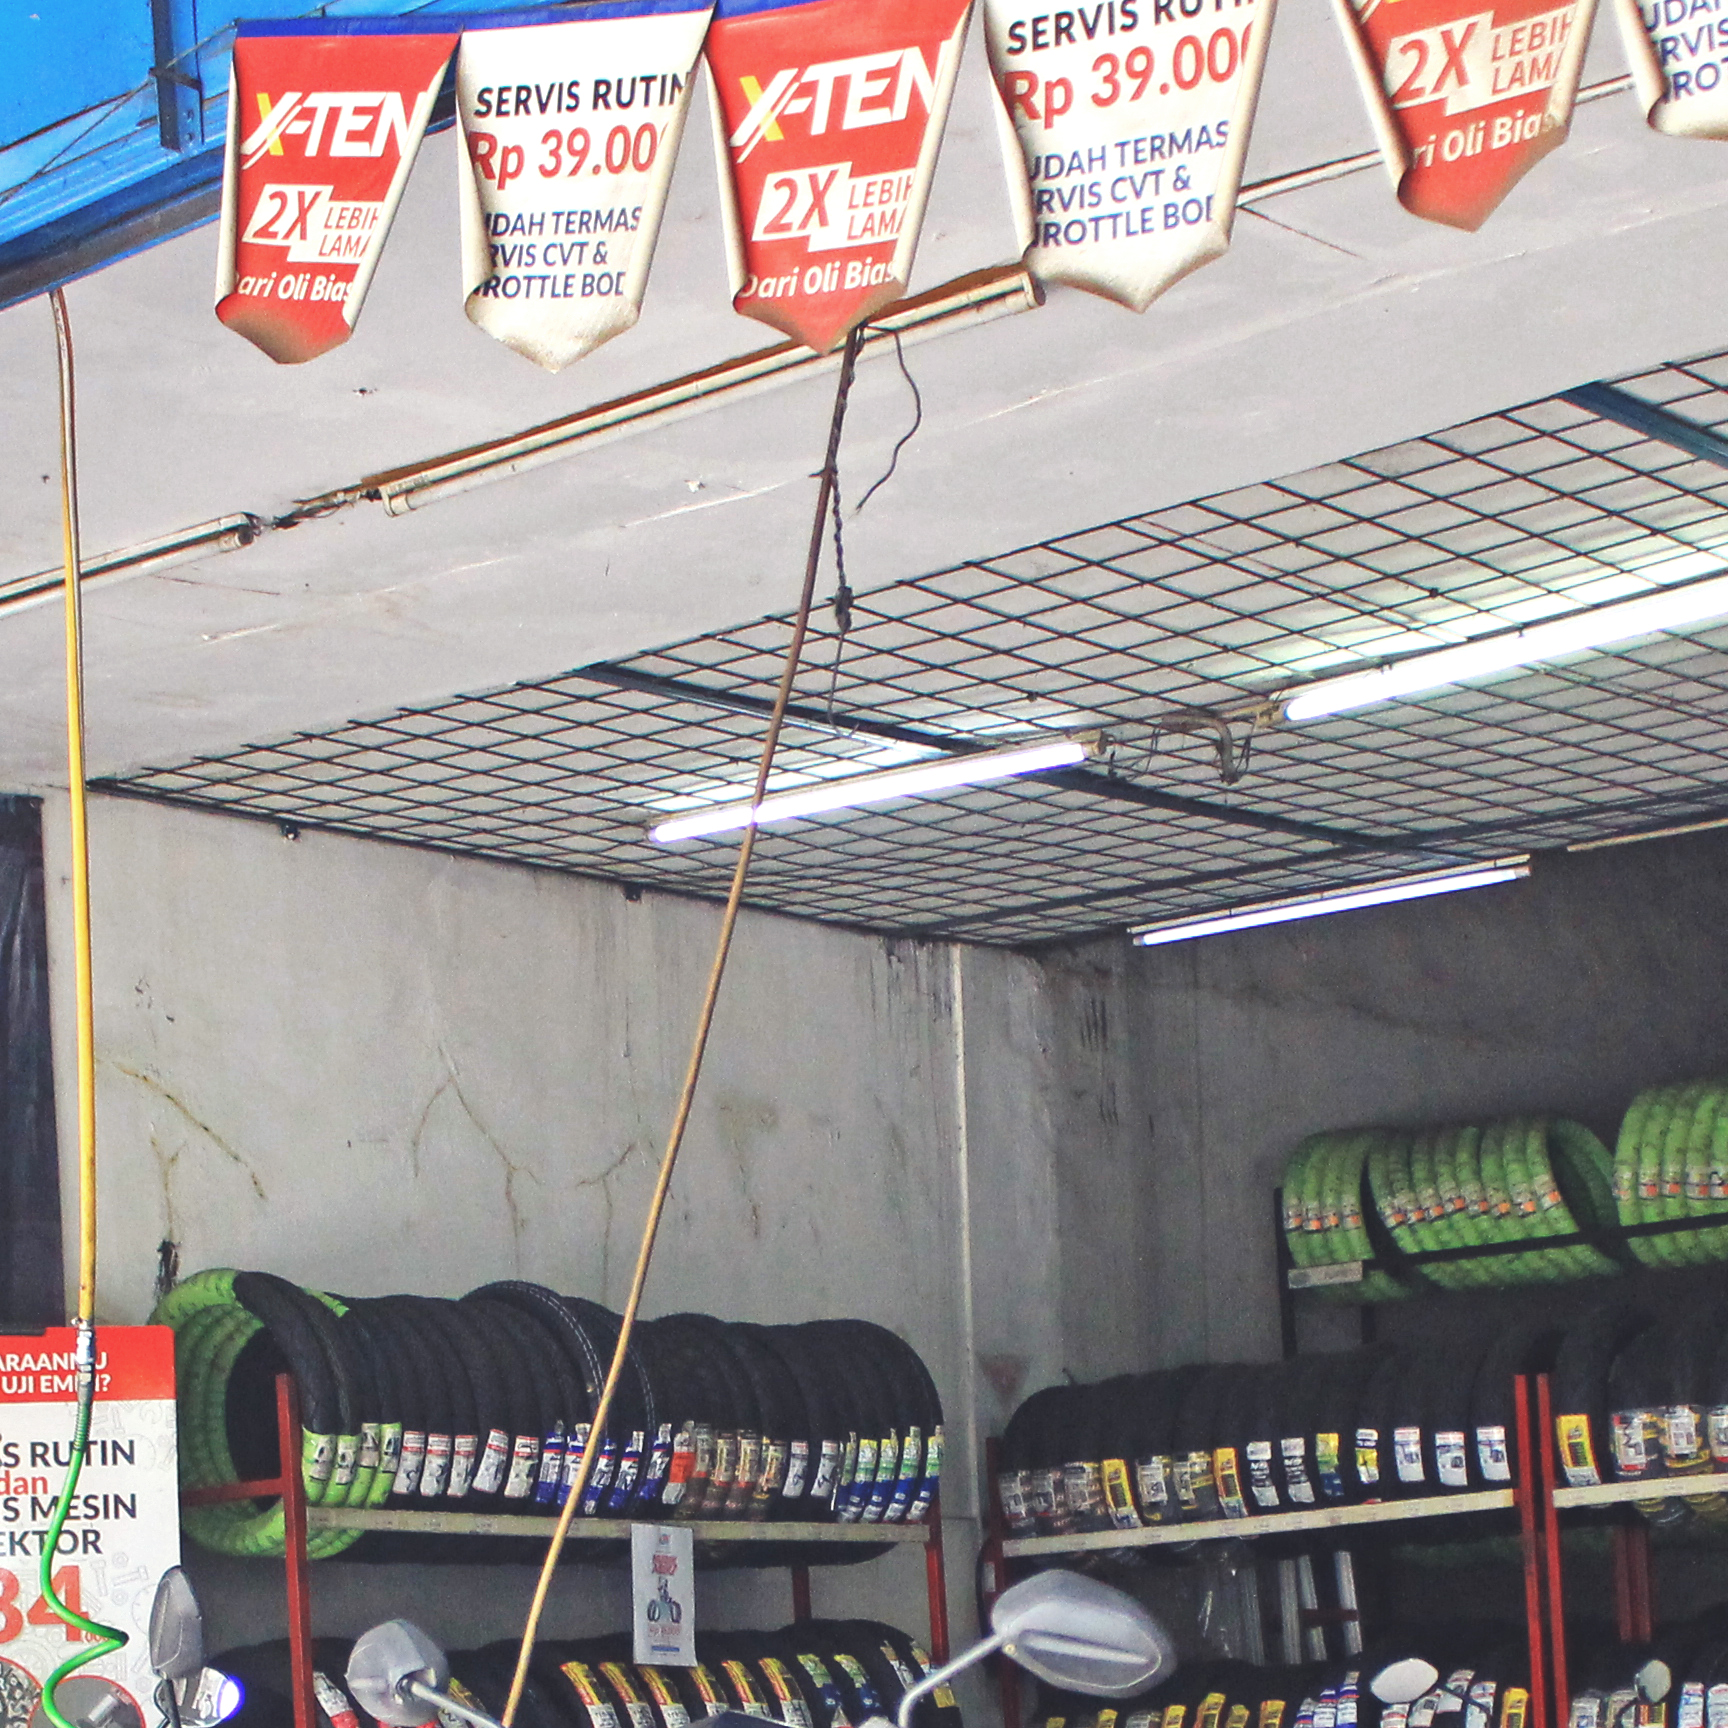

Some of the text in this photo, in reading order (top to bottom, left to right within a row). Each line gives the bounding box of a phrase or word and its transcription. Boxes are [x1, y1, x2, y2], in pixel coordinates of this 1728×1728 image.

[1006, 0, 1139, 56] SERVIS
[1393, 21, 1479, 100] 2X
[474, 80, 580, 118] SERVIS
[730, 39, 952, 163] X-TEN
[1003, 70, 1074, 130] Rp
[240, 92, 427, 169] X-TEN
[1442, 120, 1486, 162] Oli
[468, 122, 668, 190] Rp 39.00
[763, 169, 840, 234] 2X
[1110, 164, 1192, 203] CVT &
[252, 191, 322, 240] 2X
[543, 241, 608, 267] CVT &
[235, 272, 310, 300] ari Oli
[804, 261, 840, 294] Oli
[2, 1376, 34, 1394] UJI
[30, 1439, 135, 1467] RUTIN
[31, 1493, 137, 1522] MESIN
